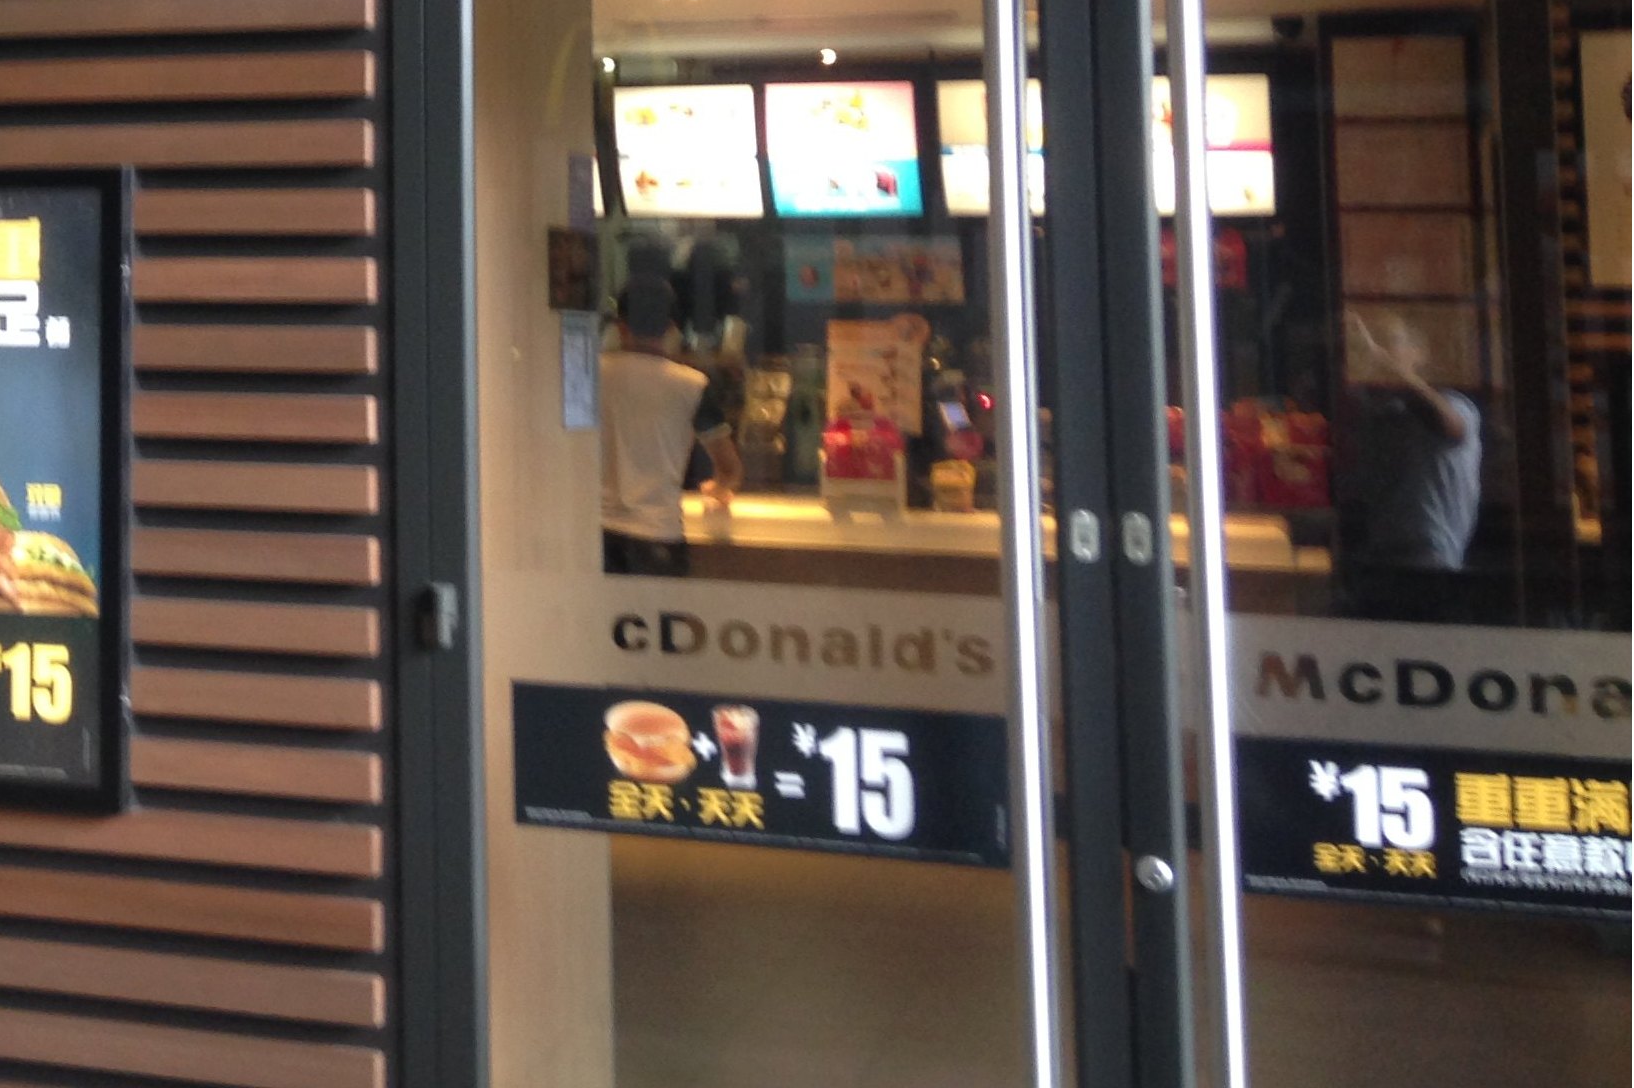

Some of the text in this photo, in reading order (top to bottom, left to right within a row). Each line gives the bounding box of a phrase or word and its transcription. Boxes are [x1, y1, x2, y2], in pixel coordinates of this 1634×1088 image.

[1454, 772, 1630, 837] 重重满
[1459, 826, 1631, 880] 含任意款
